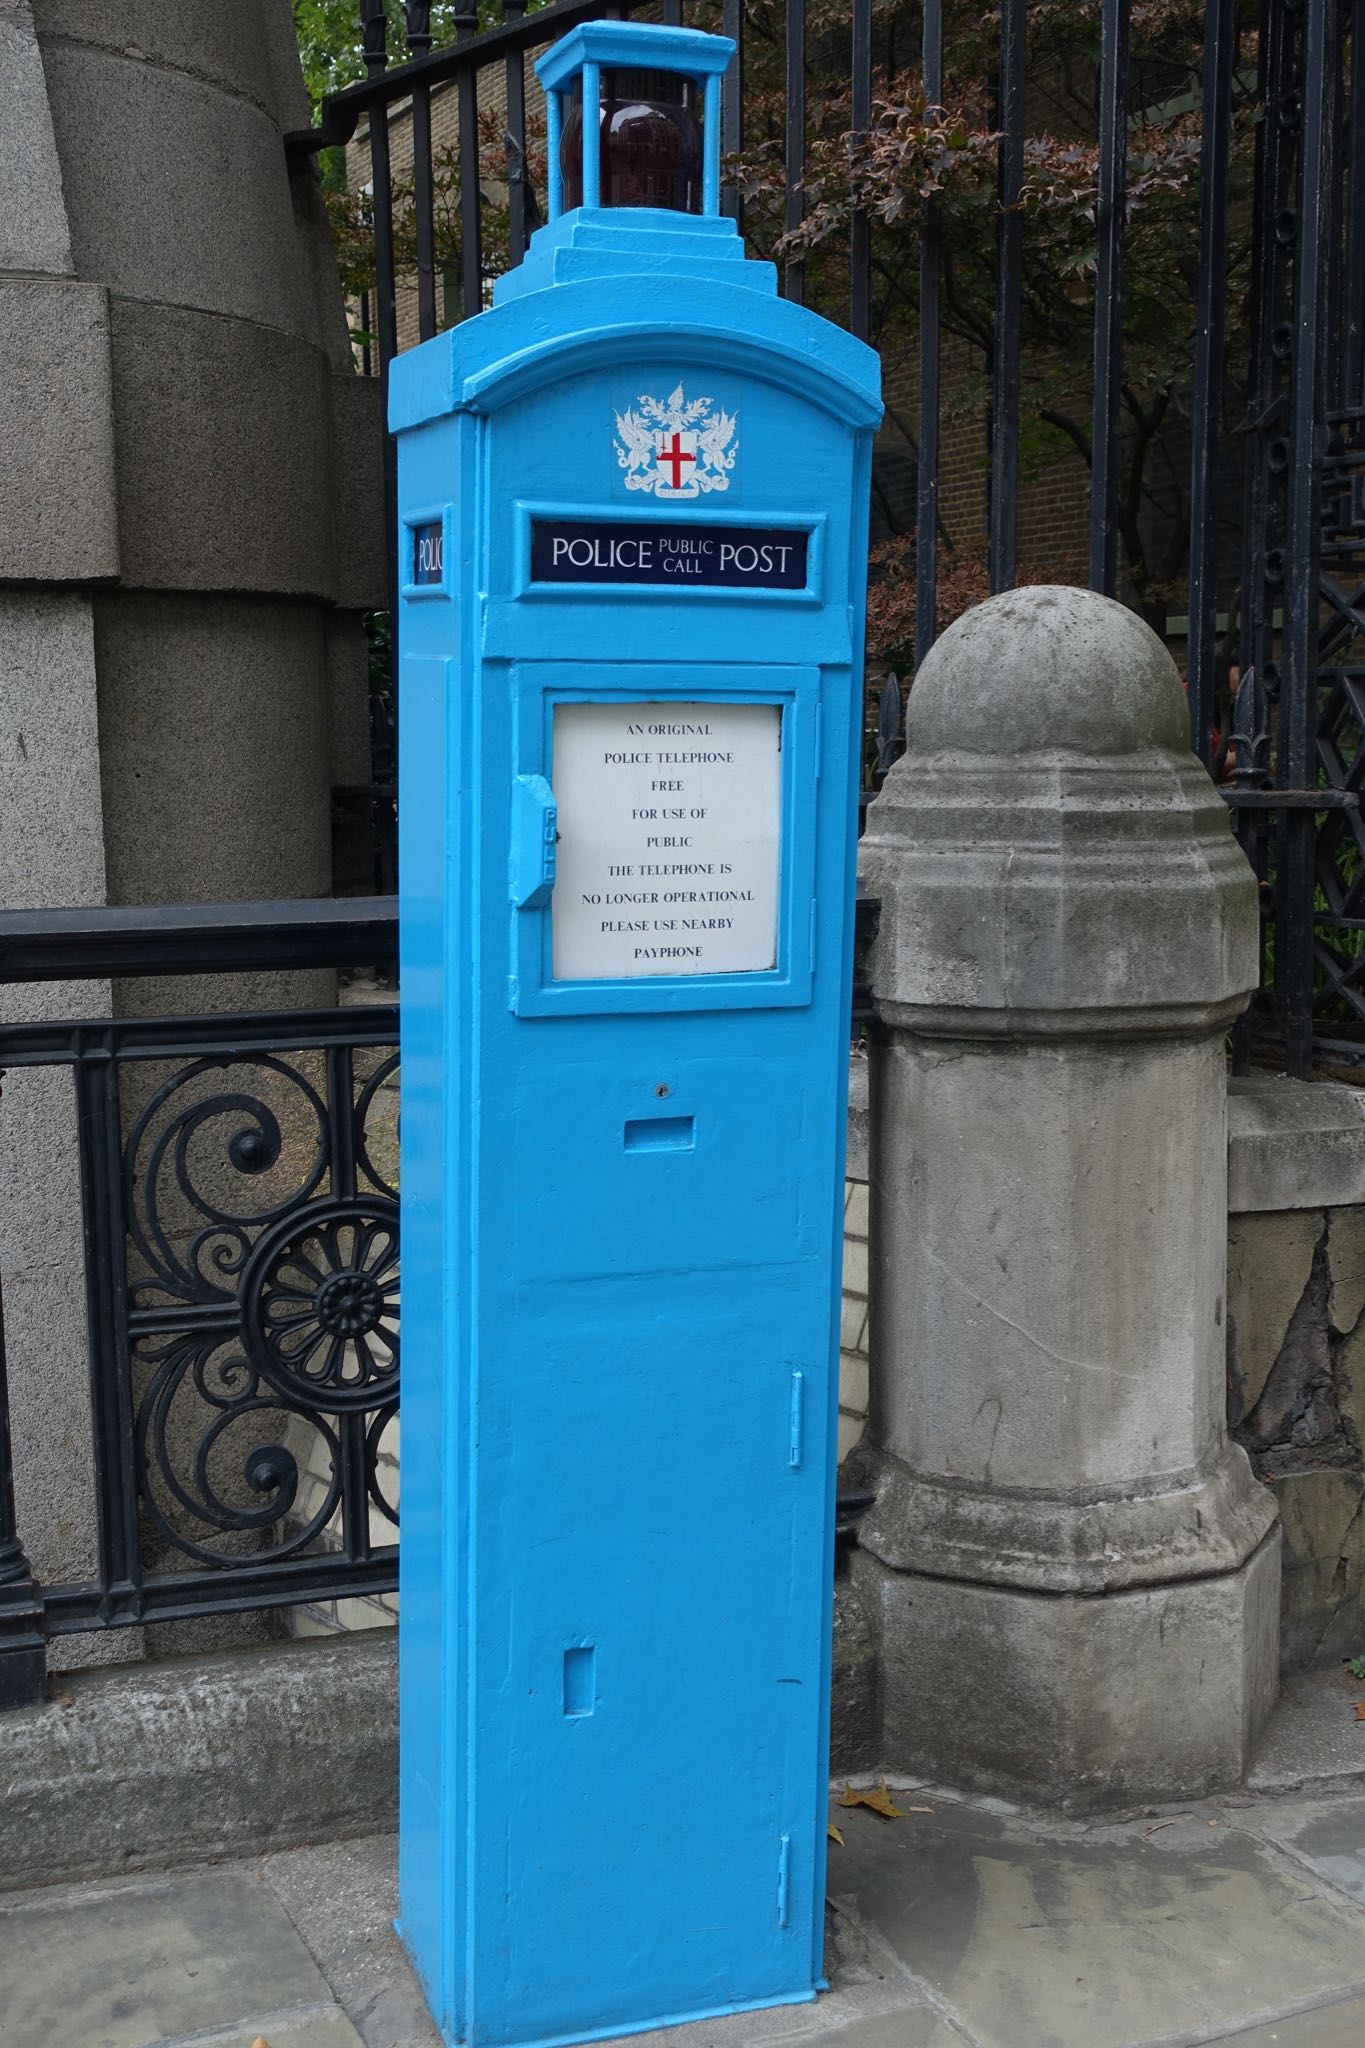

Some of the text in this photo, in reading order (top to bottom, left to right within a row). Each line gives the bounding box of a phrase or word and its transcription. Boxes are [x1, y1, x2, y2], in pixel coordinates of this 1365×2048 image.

[553, 538, 792, 572] POLICE PUBLIC POST
[664, 558, 702, 573] CALL
[626, 723, 713, 735] AN ORIGINAL
[604, 752, 734, 764] POLICE TELEPHONE
[651, 780, 684, 792] FREE
[632, 808, 708, 820] FOR USE OF
[544, 808, 556, 880] PULL
[646, 836, 693, 848] PUBLIC
[608, 863, 732, 877] THE TELEPHONE IS
[582, 890, 755, 905] NO LONGER OPERATIONAL
[601, 918, 734, 932] PLEASE USE NEARBY
[634, 946, 703, 959] PAYPHONE
